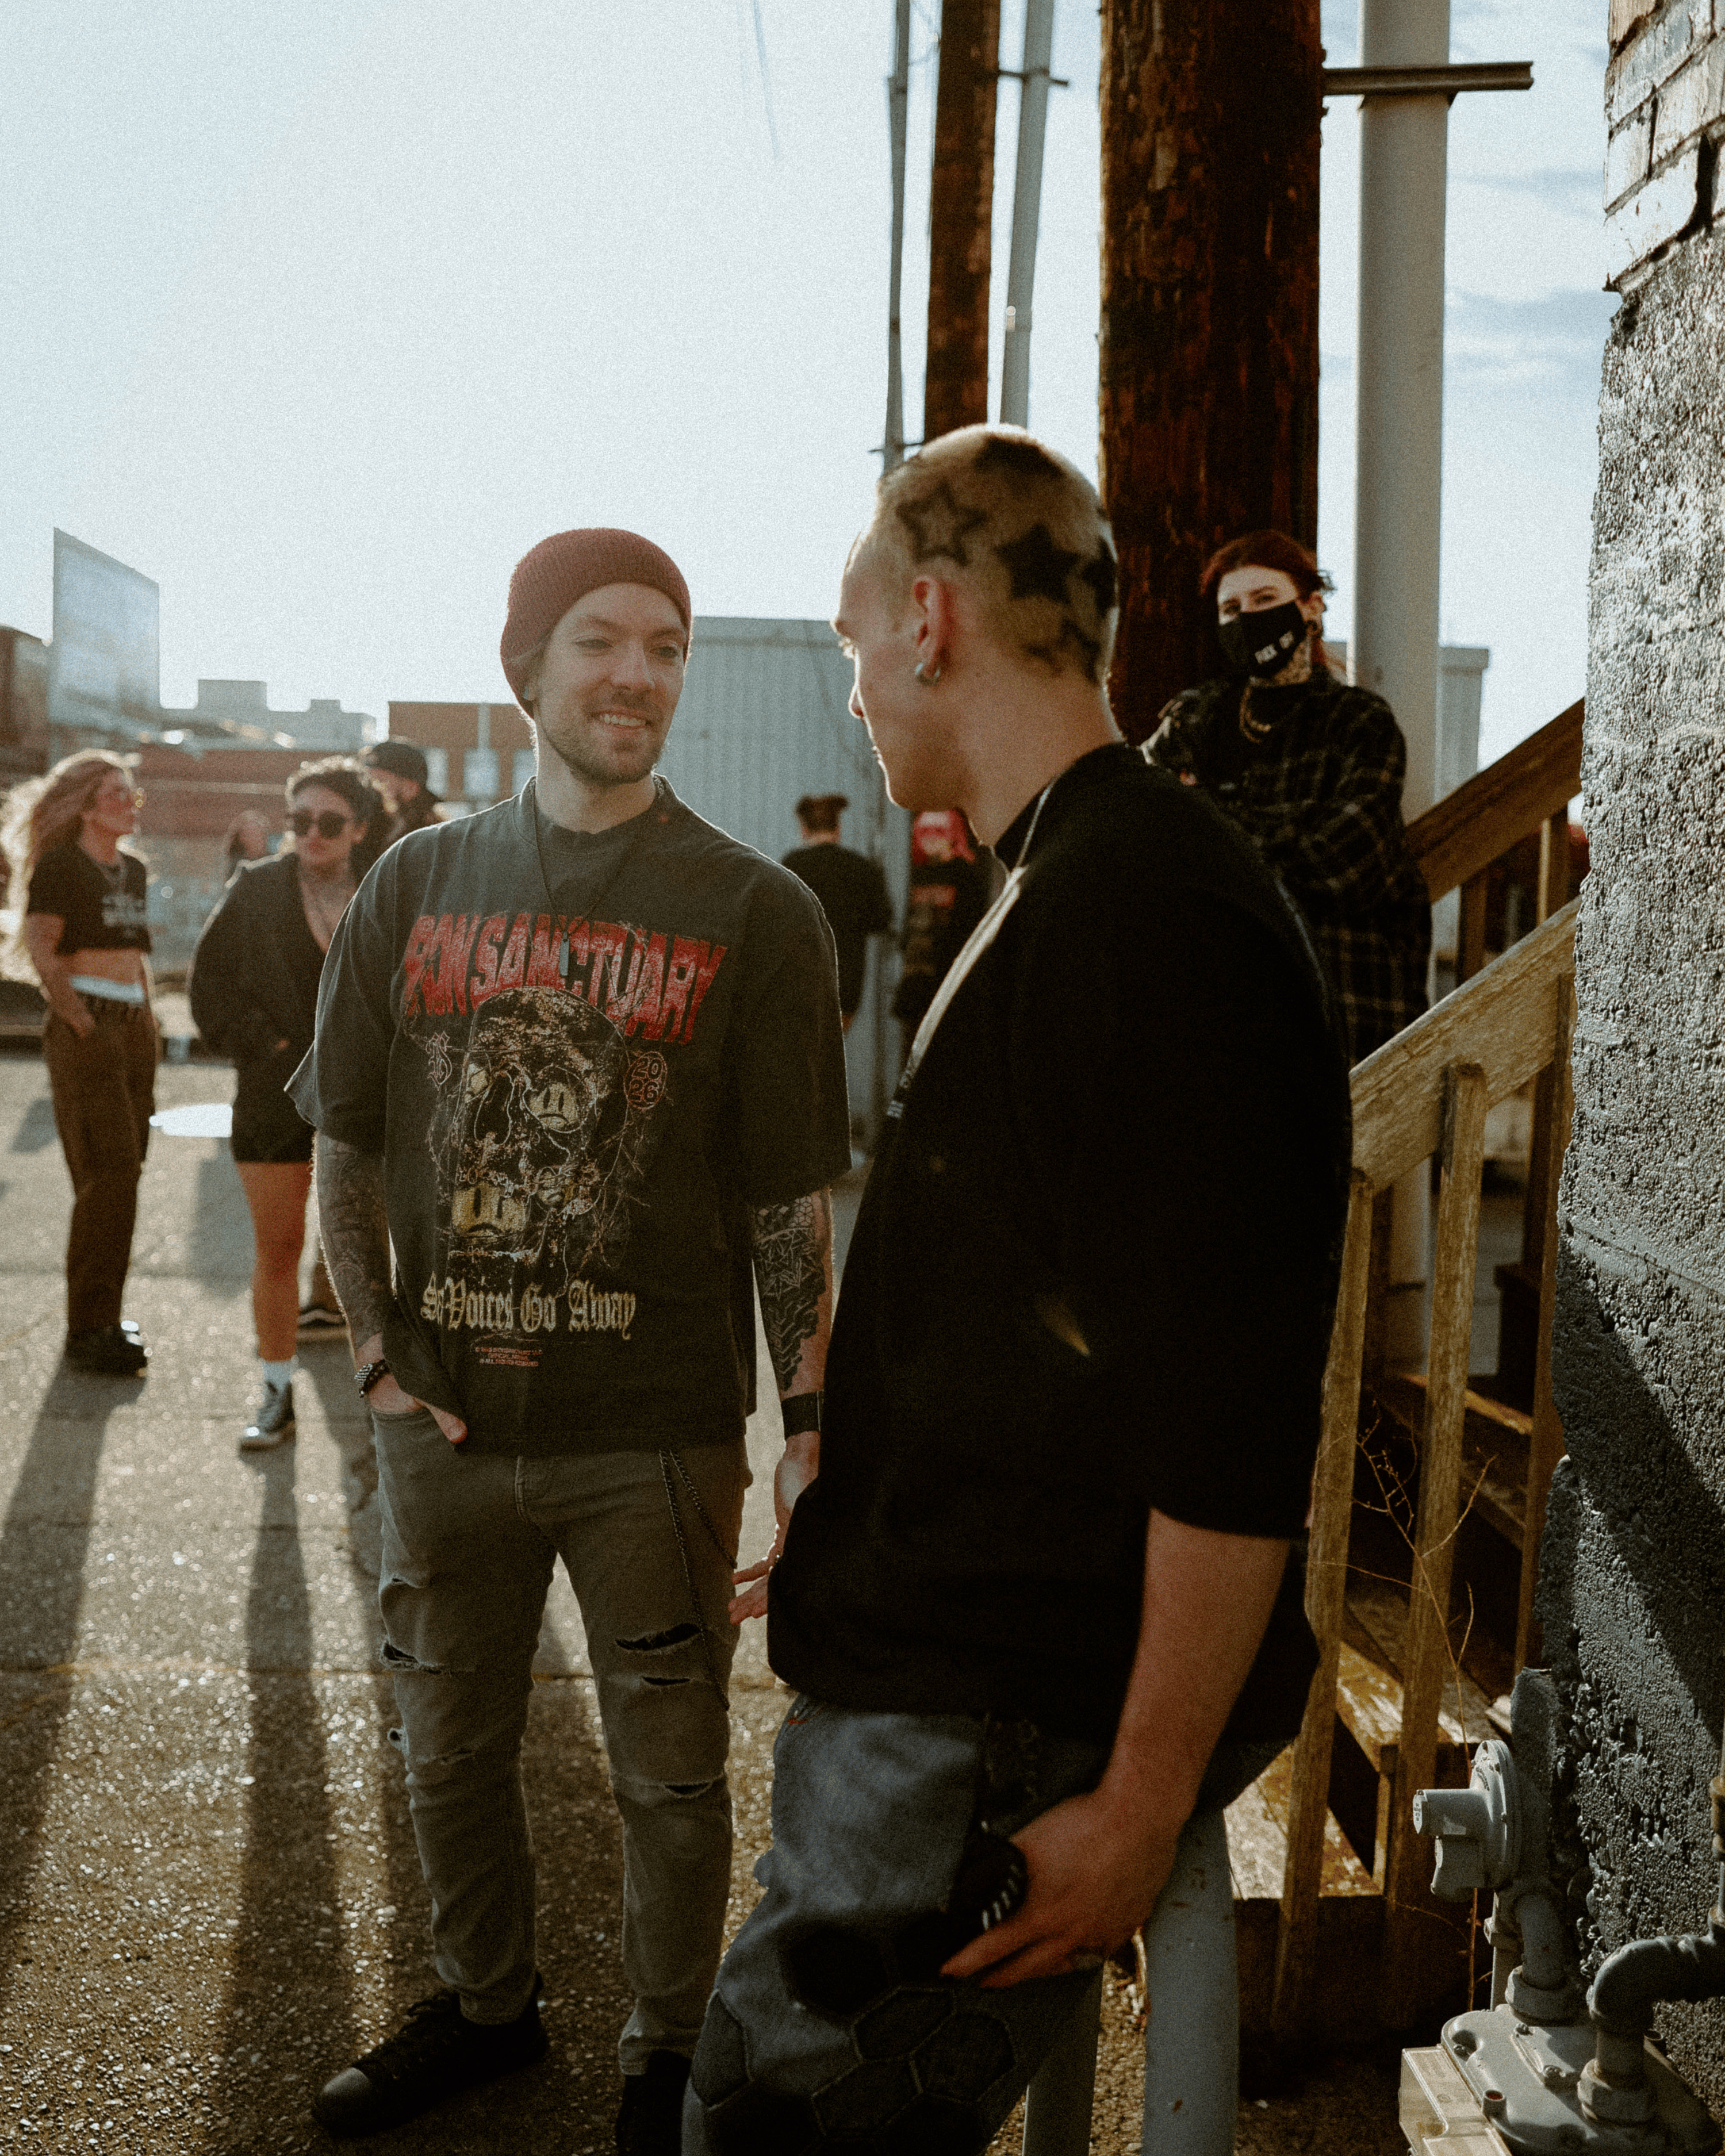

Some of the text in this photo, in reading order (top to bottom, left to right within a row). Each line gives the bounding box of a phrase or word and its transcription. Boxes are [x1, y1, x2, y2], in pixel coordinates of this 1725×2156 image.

[469, 912, 727, 1045] SANCTUARY
[520, 1281, 557, 1333] Go
[568, 1279, 636, 1341] Away
